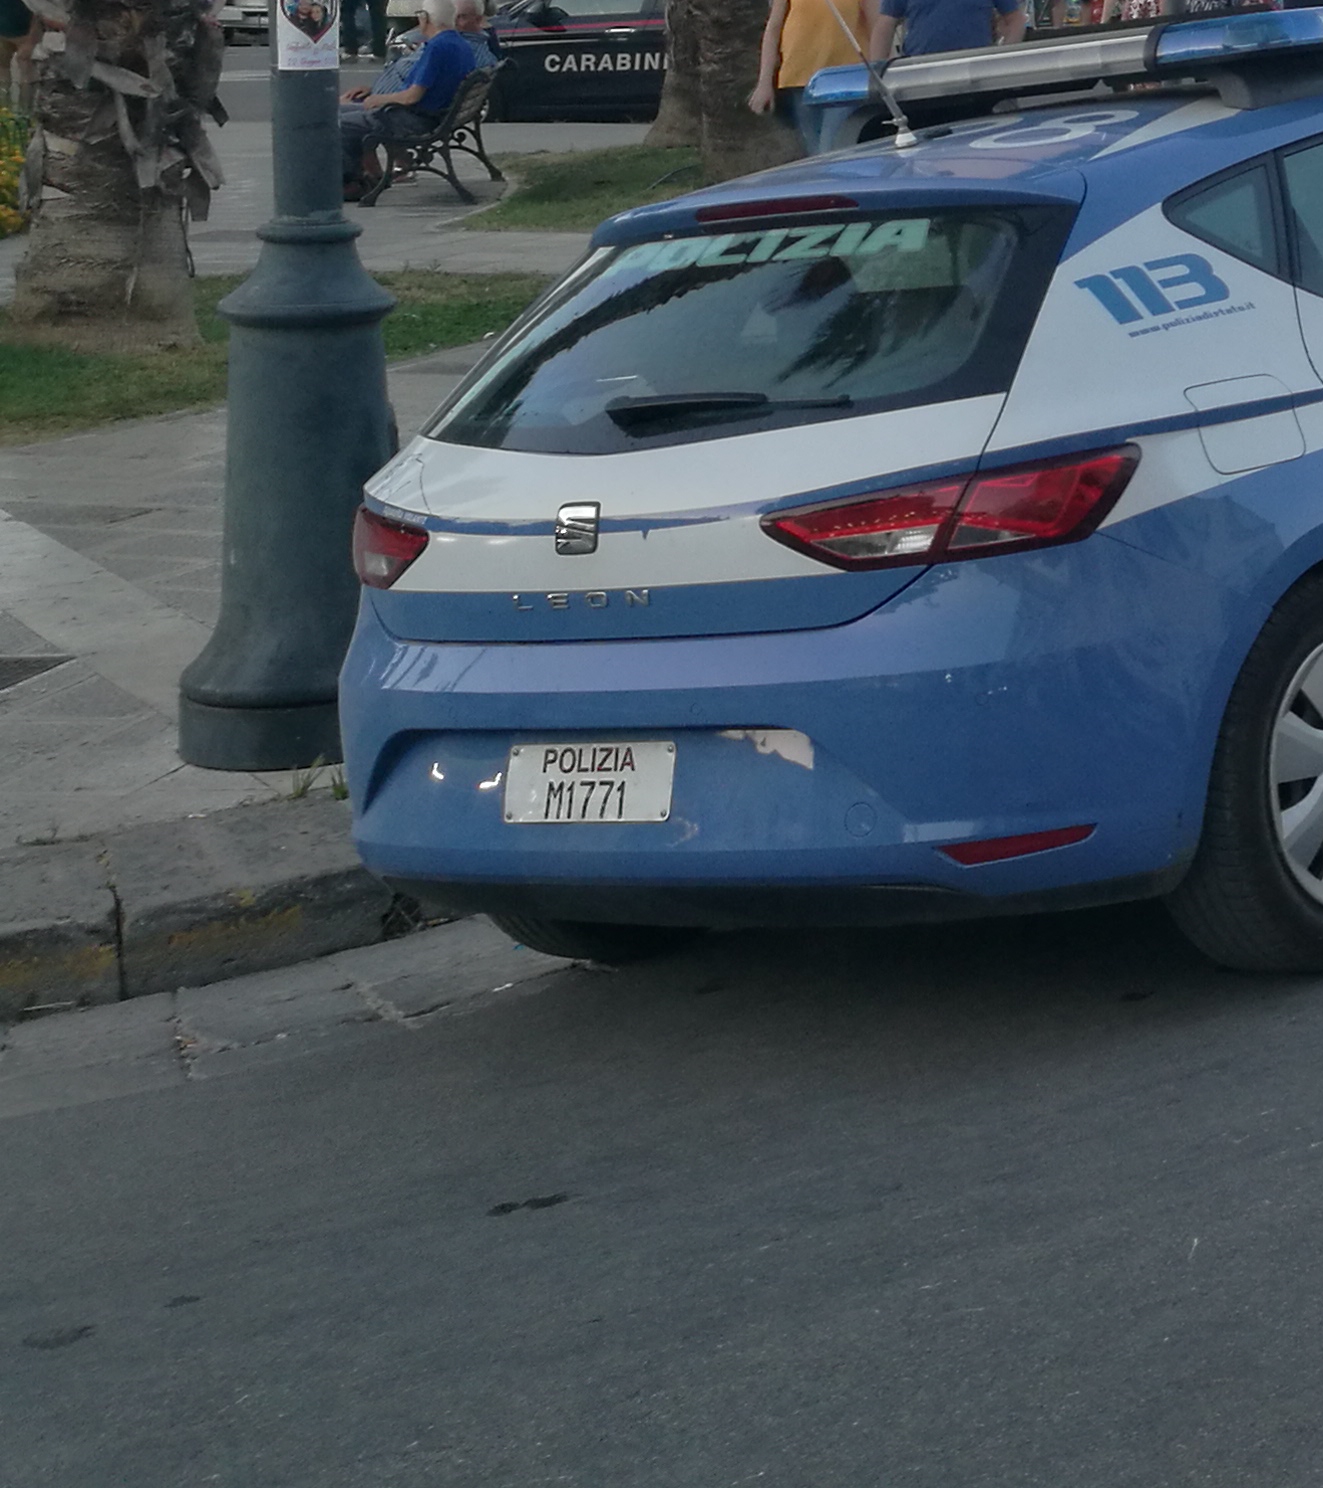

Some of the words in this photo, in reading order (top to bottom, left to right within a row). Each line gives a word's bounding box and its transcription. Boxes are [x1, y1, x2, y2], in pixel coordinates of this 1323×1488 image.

[544, 53, 670, 72] CARABINI
[618, 218, 931, 272] POLIZIA
[1074, 253, 1230, 325] 113
[512, 589, 650, 610] LEON
[542, 747, 635, 773] POLIZIA
[544, 780, 626, 820] M1771
